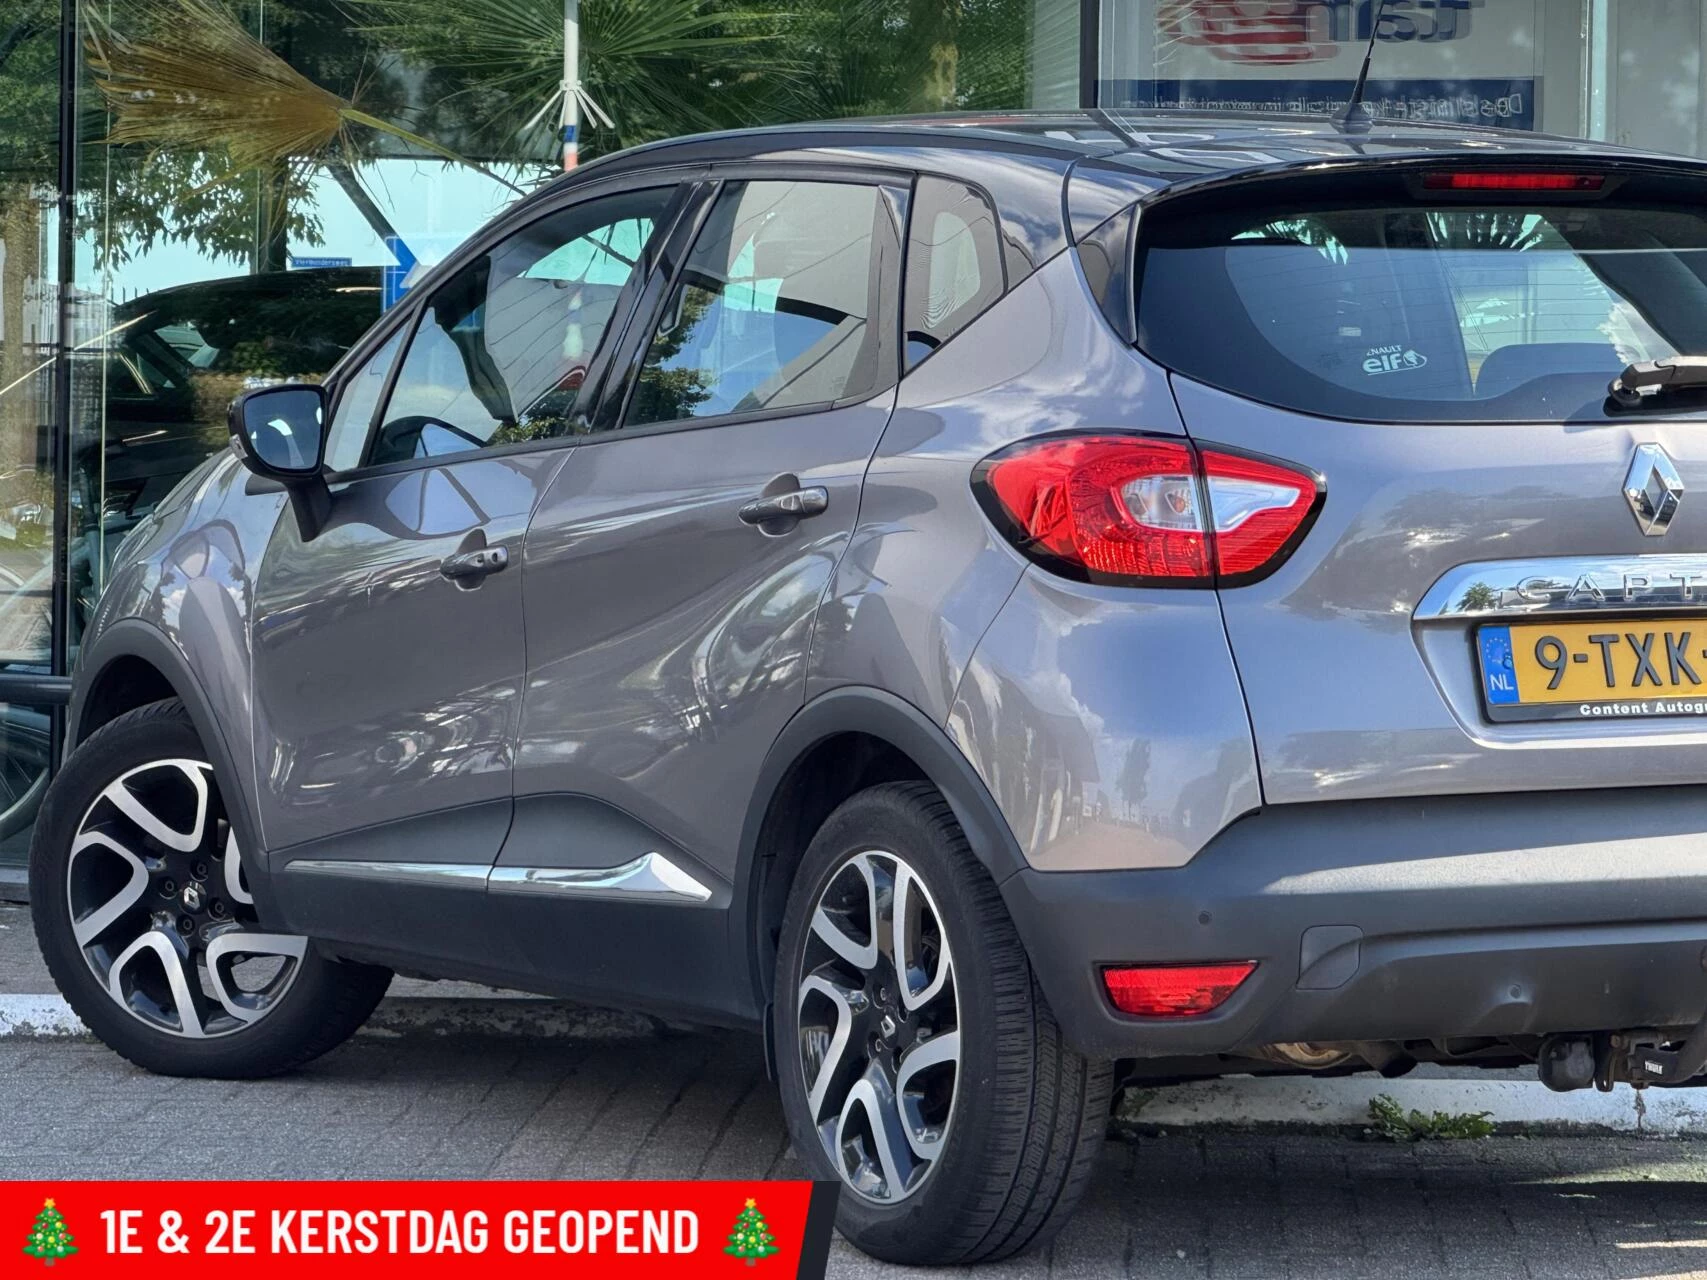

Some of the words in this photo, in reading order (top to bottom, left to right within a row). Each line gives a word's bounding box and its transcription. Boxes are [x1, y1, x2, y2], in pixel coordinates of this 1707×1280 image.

[1362, 352, 1402, 374] elf
[1516, 573, 1703, 601] CAPT
[1489, 673, 1514, 691] NL
[1580, 702, 1648, 716] Content
